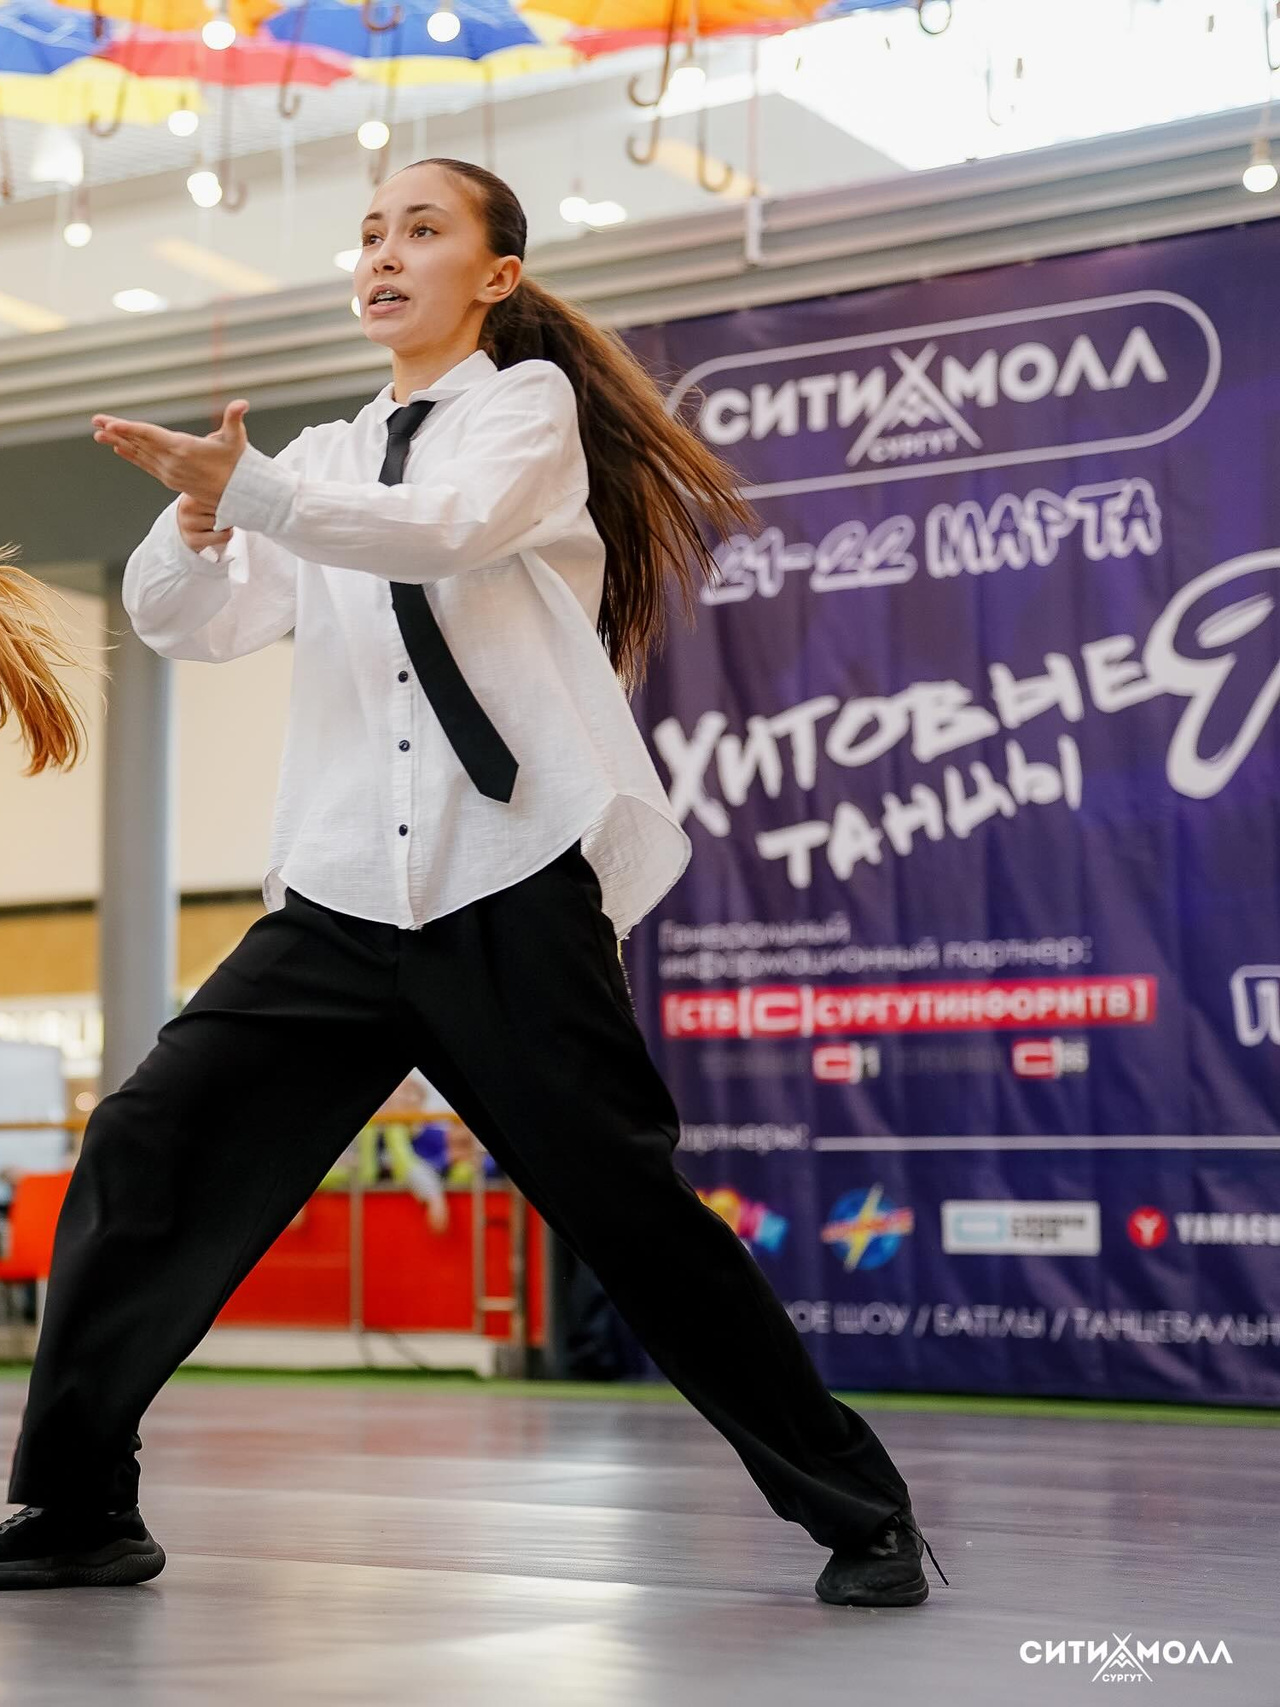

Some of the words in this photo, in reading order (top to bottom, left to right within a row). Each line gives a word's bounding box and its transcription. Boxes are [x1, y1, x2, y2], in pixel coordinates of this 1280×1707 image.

[925, 477, 1163, 579] МАРТА
[653, 634, 1150, 838] ХИТОВЫЕ
[755, 734, 1082, 889] ТАНЦЫ
[833, 1302, 911, 1336] ШОУ
